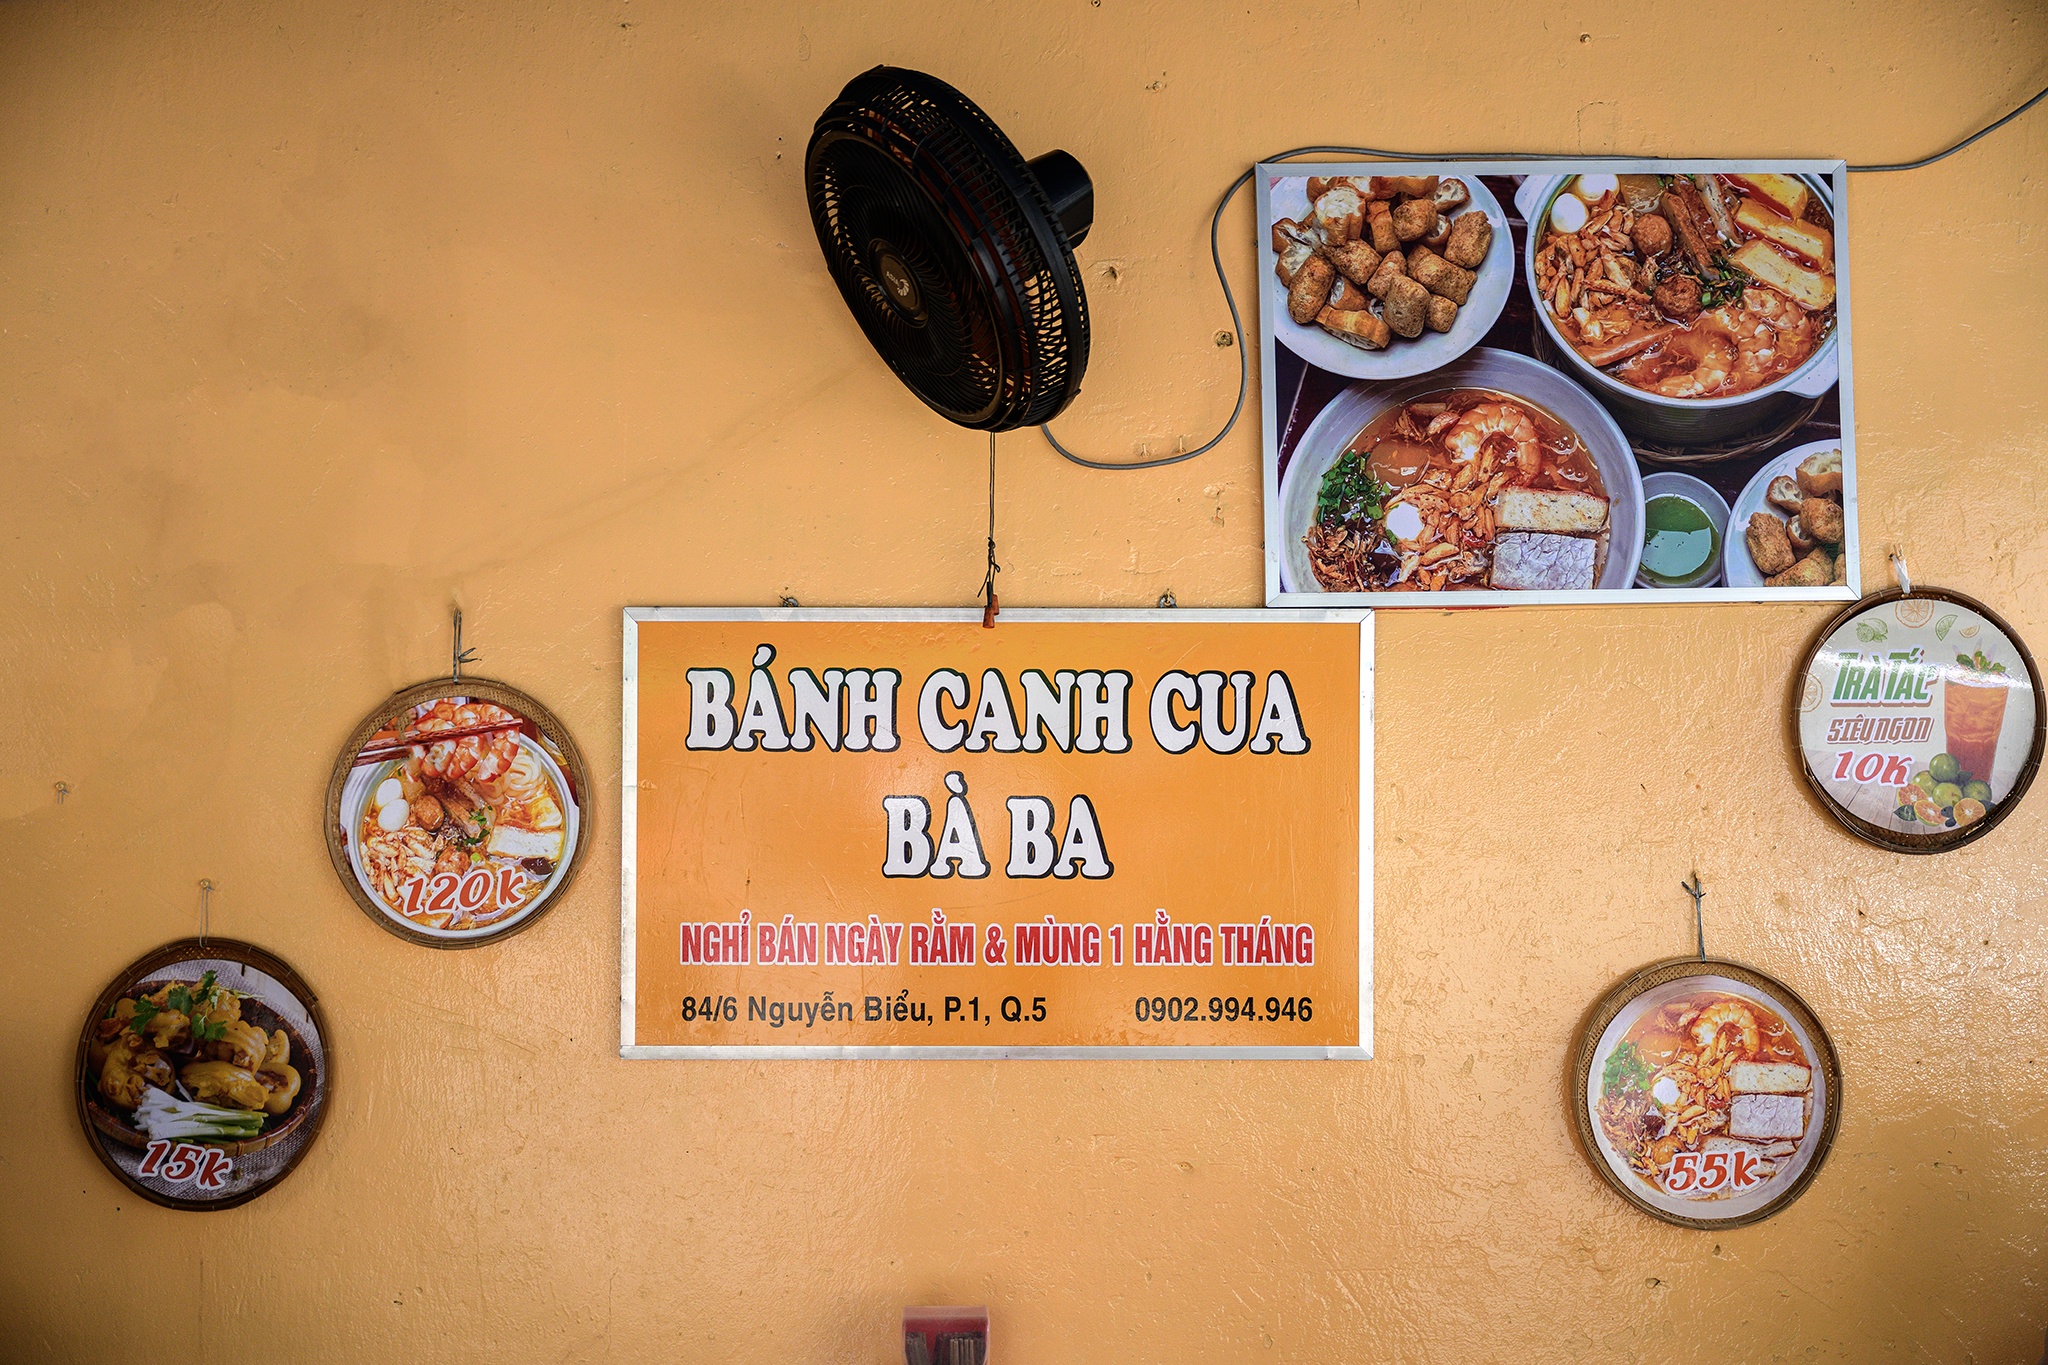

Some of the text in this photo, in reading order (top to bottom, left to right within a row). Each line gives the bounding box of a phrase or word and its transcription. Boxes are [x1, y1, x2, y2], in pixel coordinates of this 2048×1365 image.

[686, 643, 1311, 755] BÁNH CANH CUA
[882, 770, 1114, 879] BÀ BA
[680, 908, 1315, 967] NGHỈ BÁN NGÀY RẰM & MÙNG 1 HẰNG THÁNG
[681, 989, 1047, 1028] 84/6 Nguyễn Biểu, P.1, Q.5
[1135, 996, 1313, 1022] 0902.994.946
